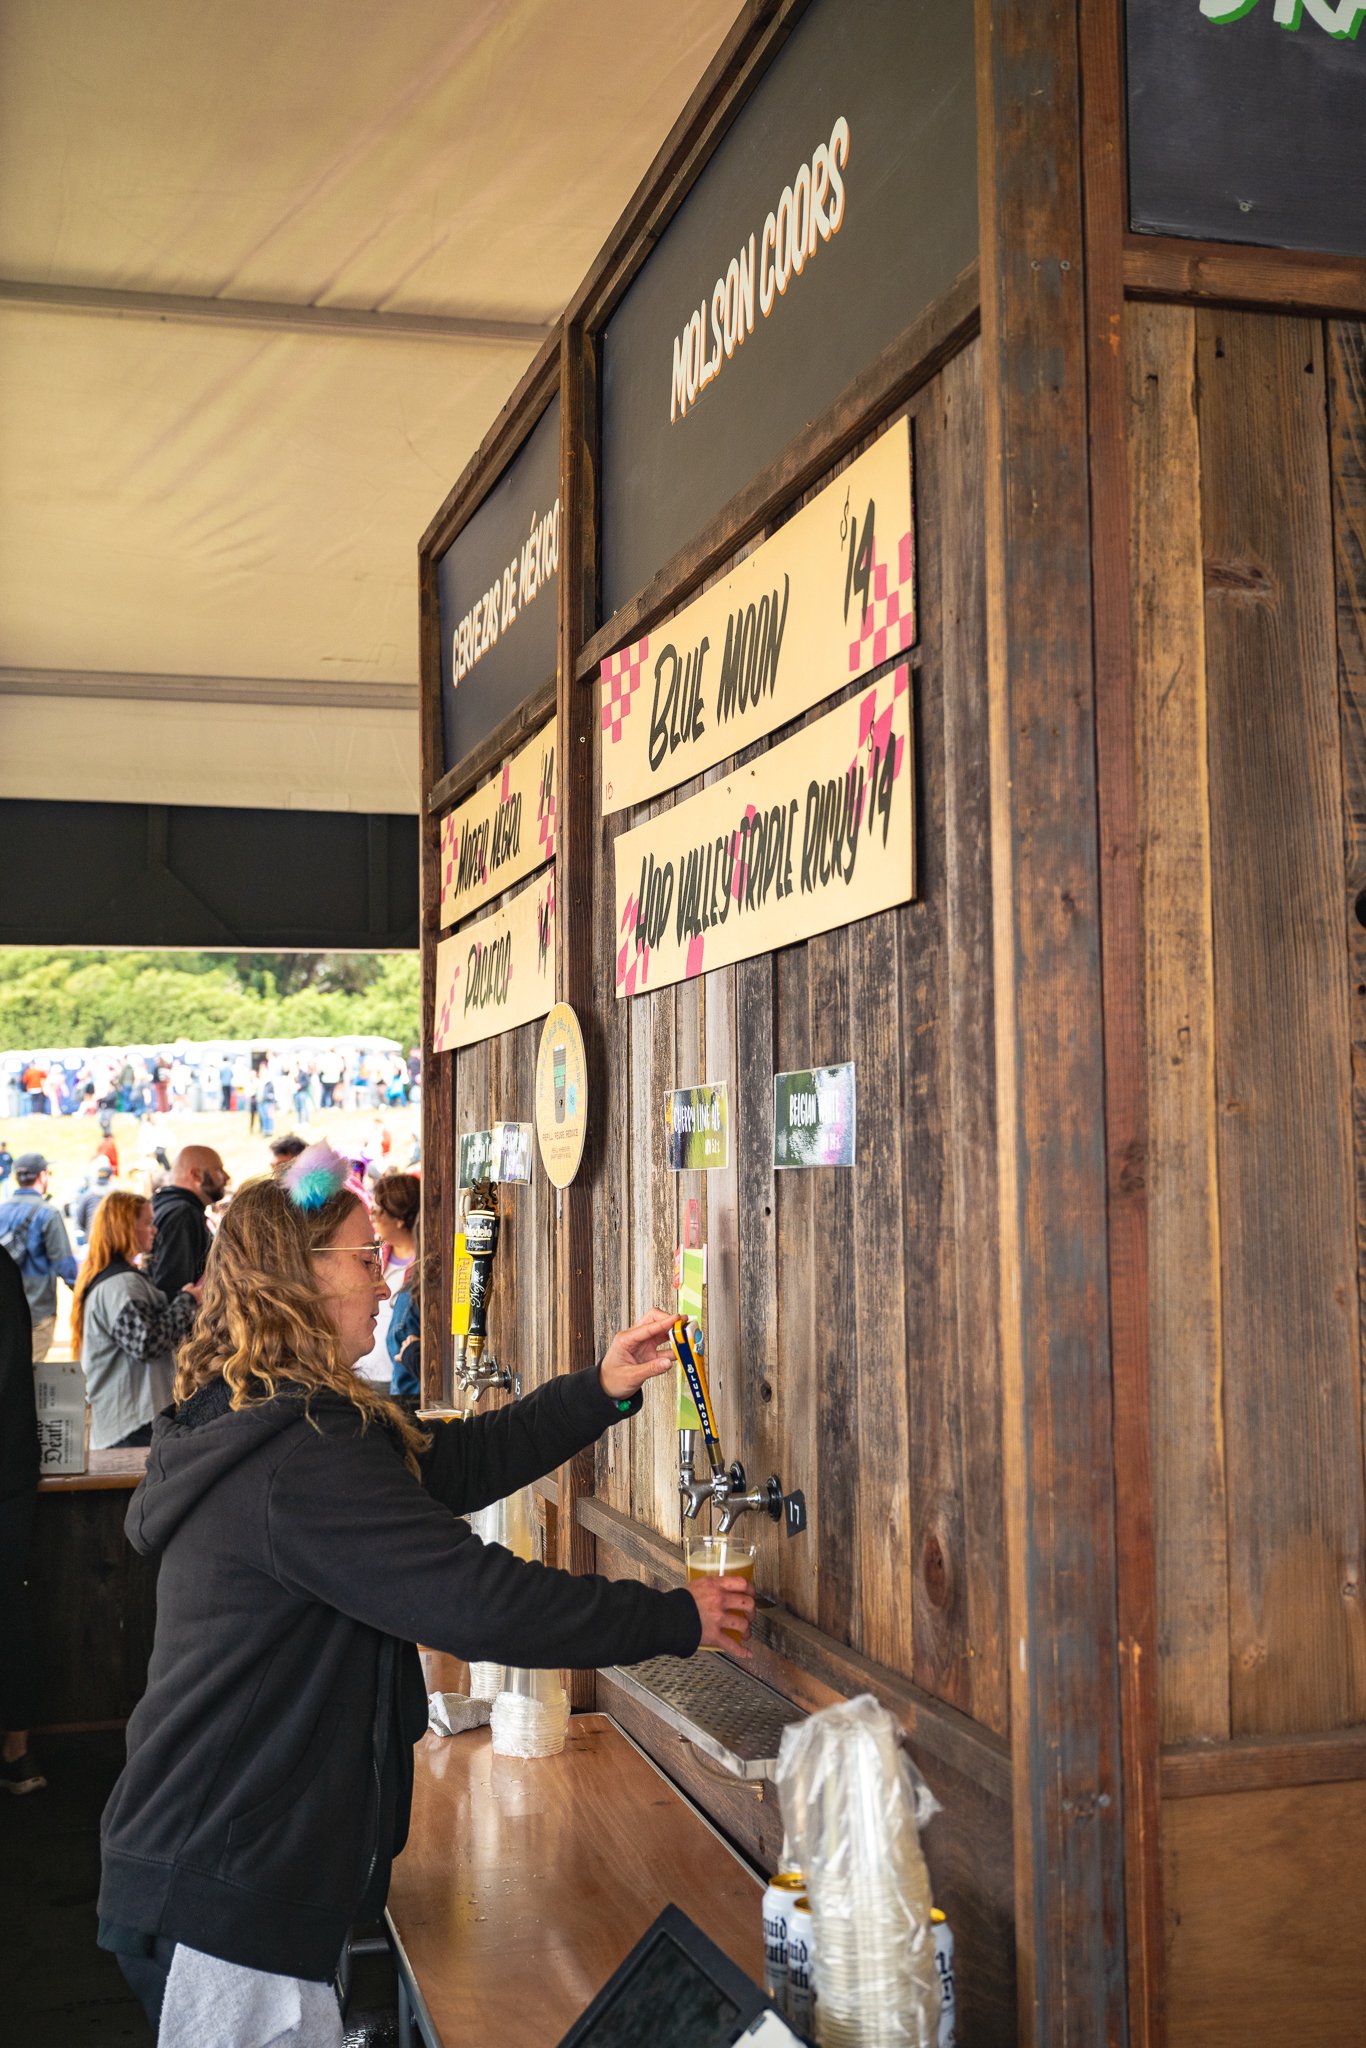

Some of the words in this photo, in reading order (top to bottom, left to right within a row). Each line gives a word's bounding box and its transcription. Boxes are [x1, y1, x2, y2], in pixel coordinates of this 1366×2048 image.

[670, 231, 756, 426] MOLSON
[759, 116, 850, 318] COORS
[452, 578, 501, 689] CERVEZAS
[501, 557, 518, 635] DE
[518, 497, 560, 612] MÉXICO
[648, 636, 711, 772] BLUE
[716, 572, 790, 728] MOON
[839, 484, 876, 628] $14
[453, 817, 490, 900] MODELO
[489, 791, 522, 875] NEGRA
[635, 852, 675, 955] HOP
[676, 829, 737, 948] VALLEY
[737, 798, 799, 916] TRIPLE
[800, 765, 865, 896] RICKY
[866, 706, 897, 850] $14
[464, 929, 512, 1018] PACIFICO
[789, 1092, 817, 1127] BELGIAN
[686, 1363, 702, 1398] BLUE
[697, 1402, 712, 1436] MOON
